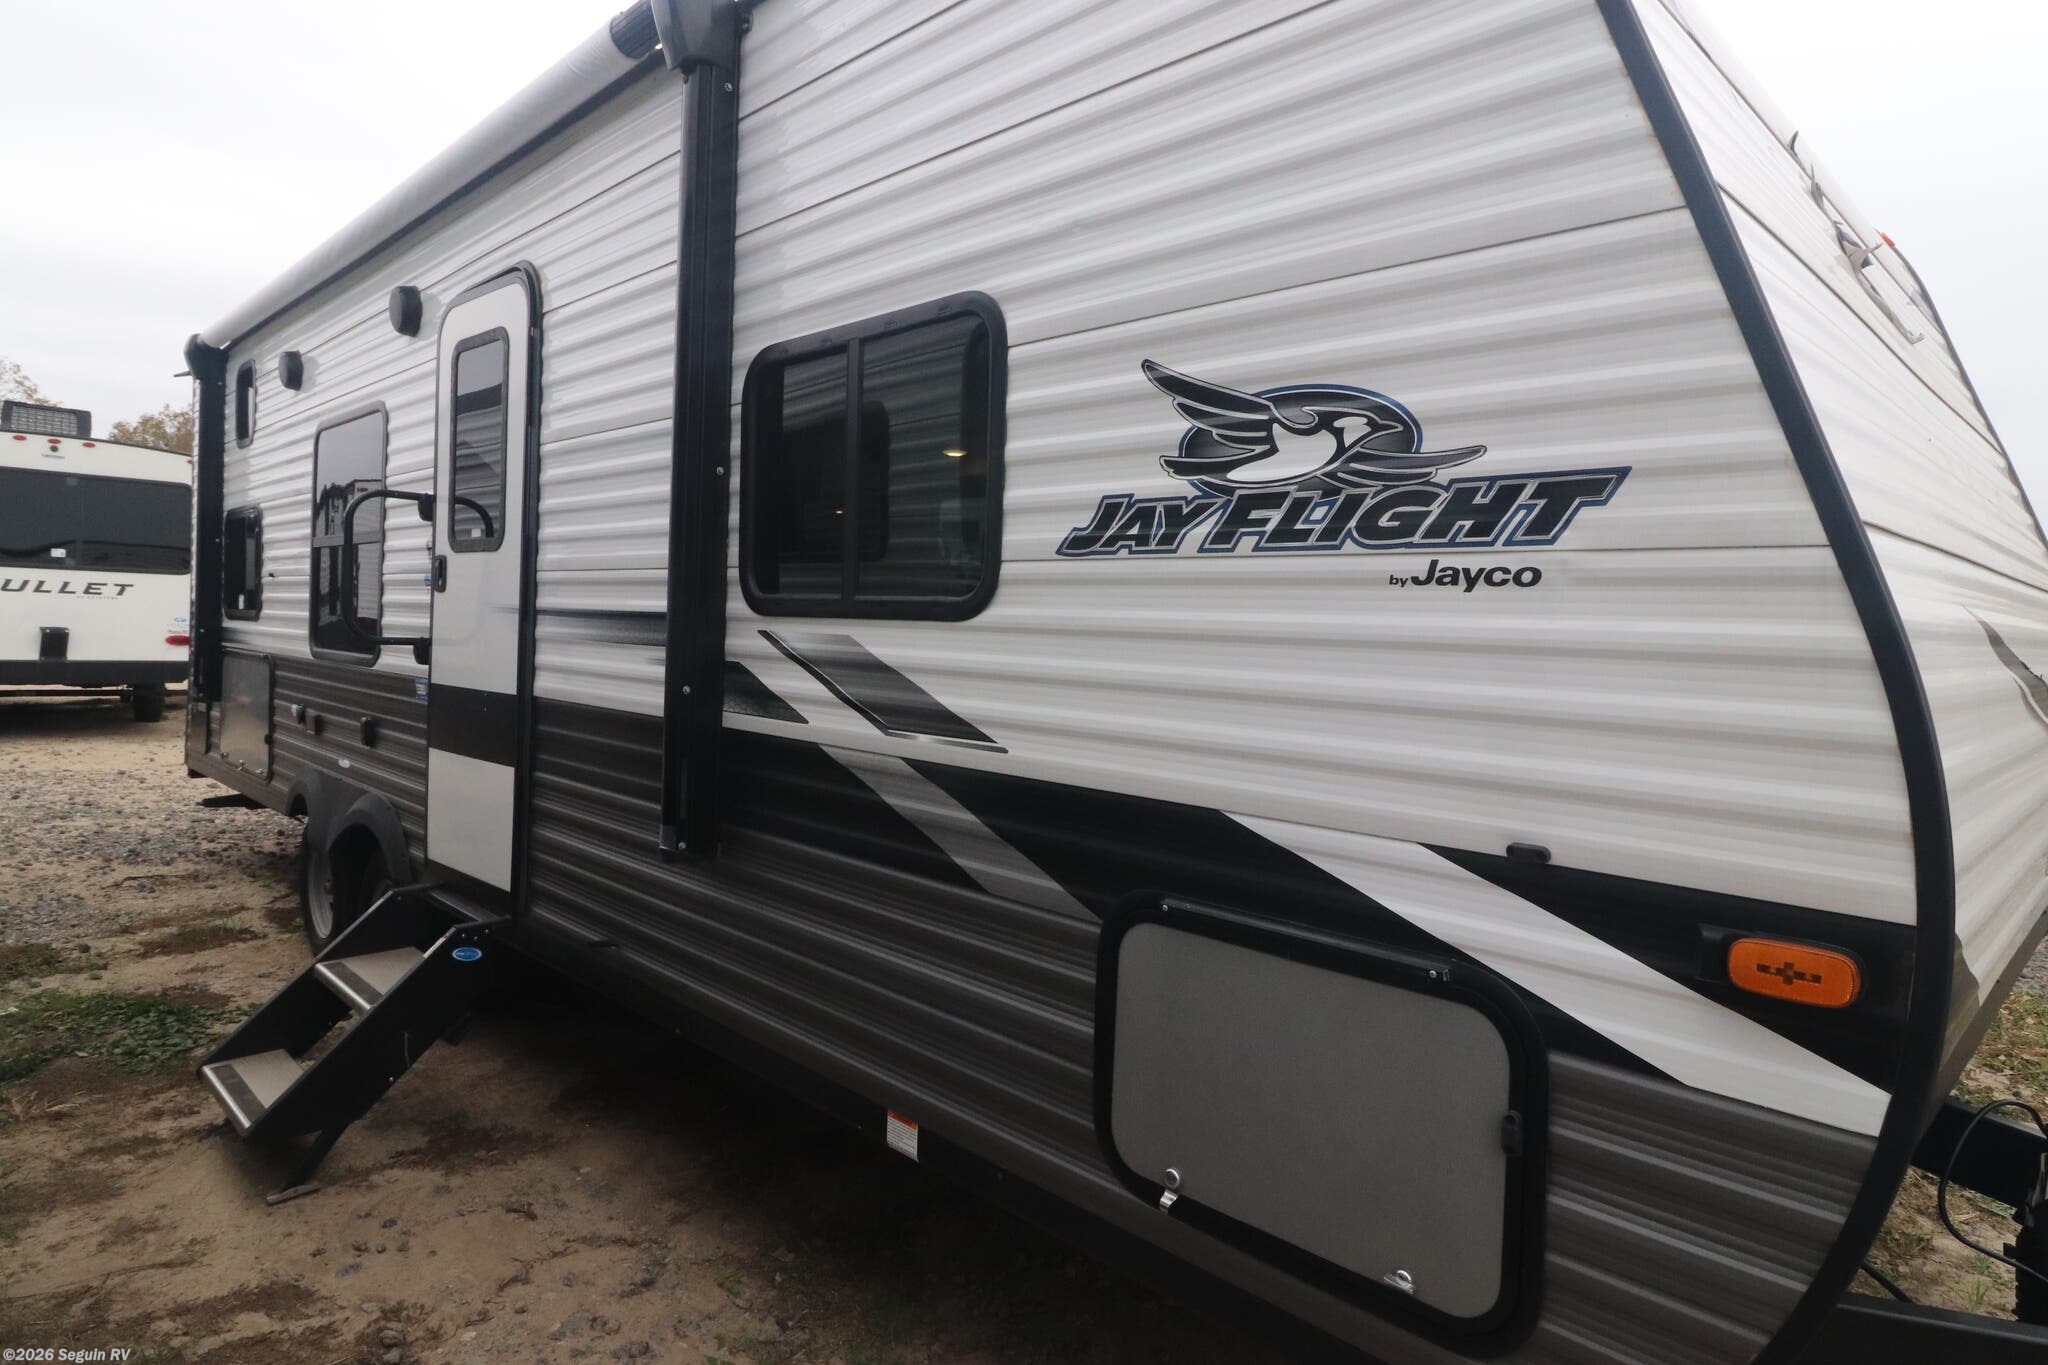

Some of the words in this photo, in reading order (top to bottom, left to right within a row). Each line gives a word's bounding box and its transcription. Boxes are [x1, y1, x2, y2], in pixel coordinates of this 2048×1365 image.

[1056, 493, 1226, 557] JAY
[1197, 466, 1632, 553] FLIGHT
[1389, 575, 1408, 588] by
[1410, 559, 1543, 593] Jayco
